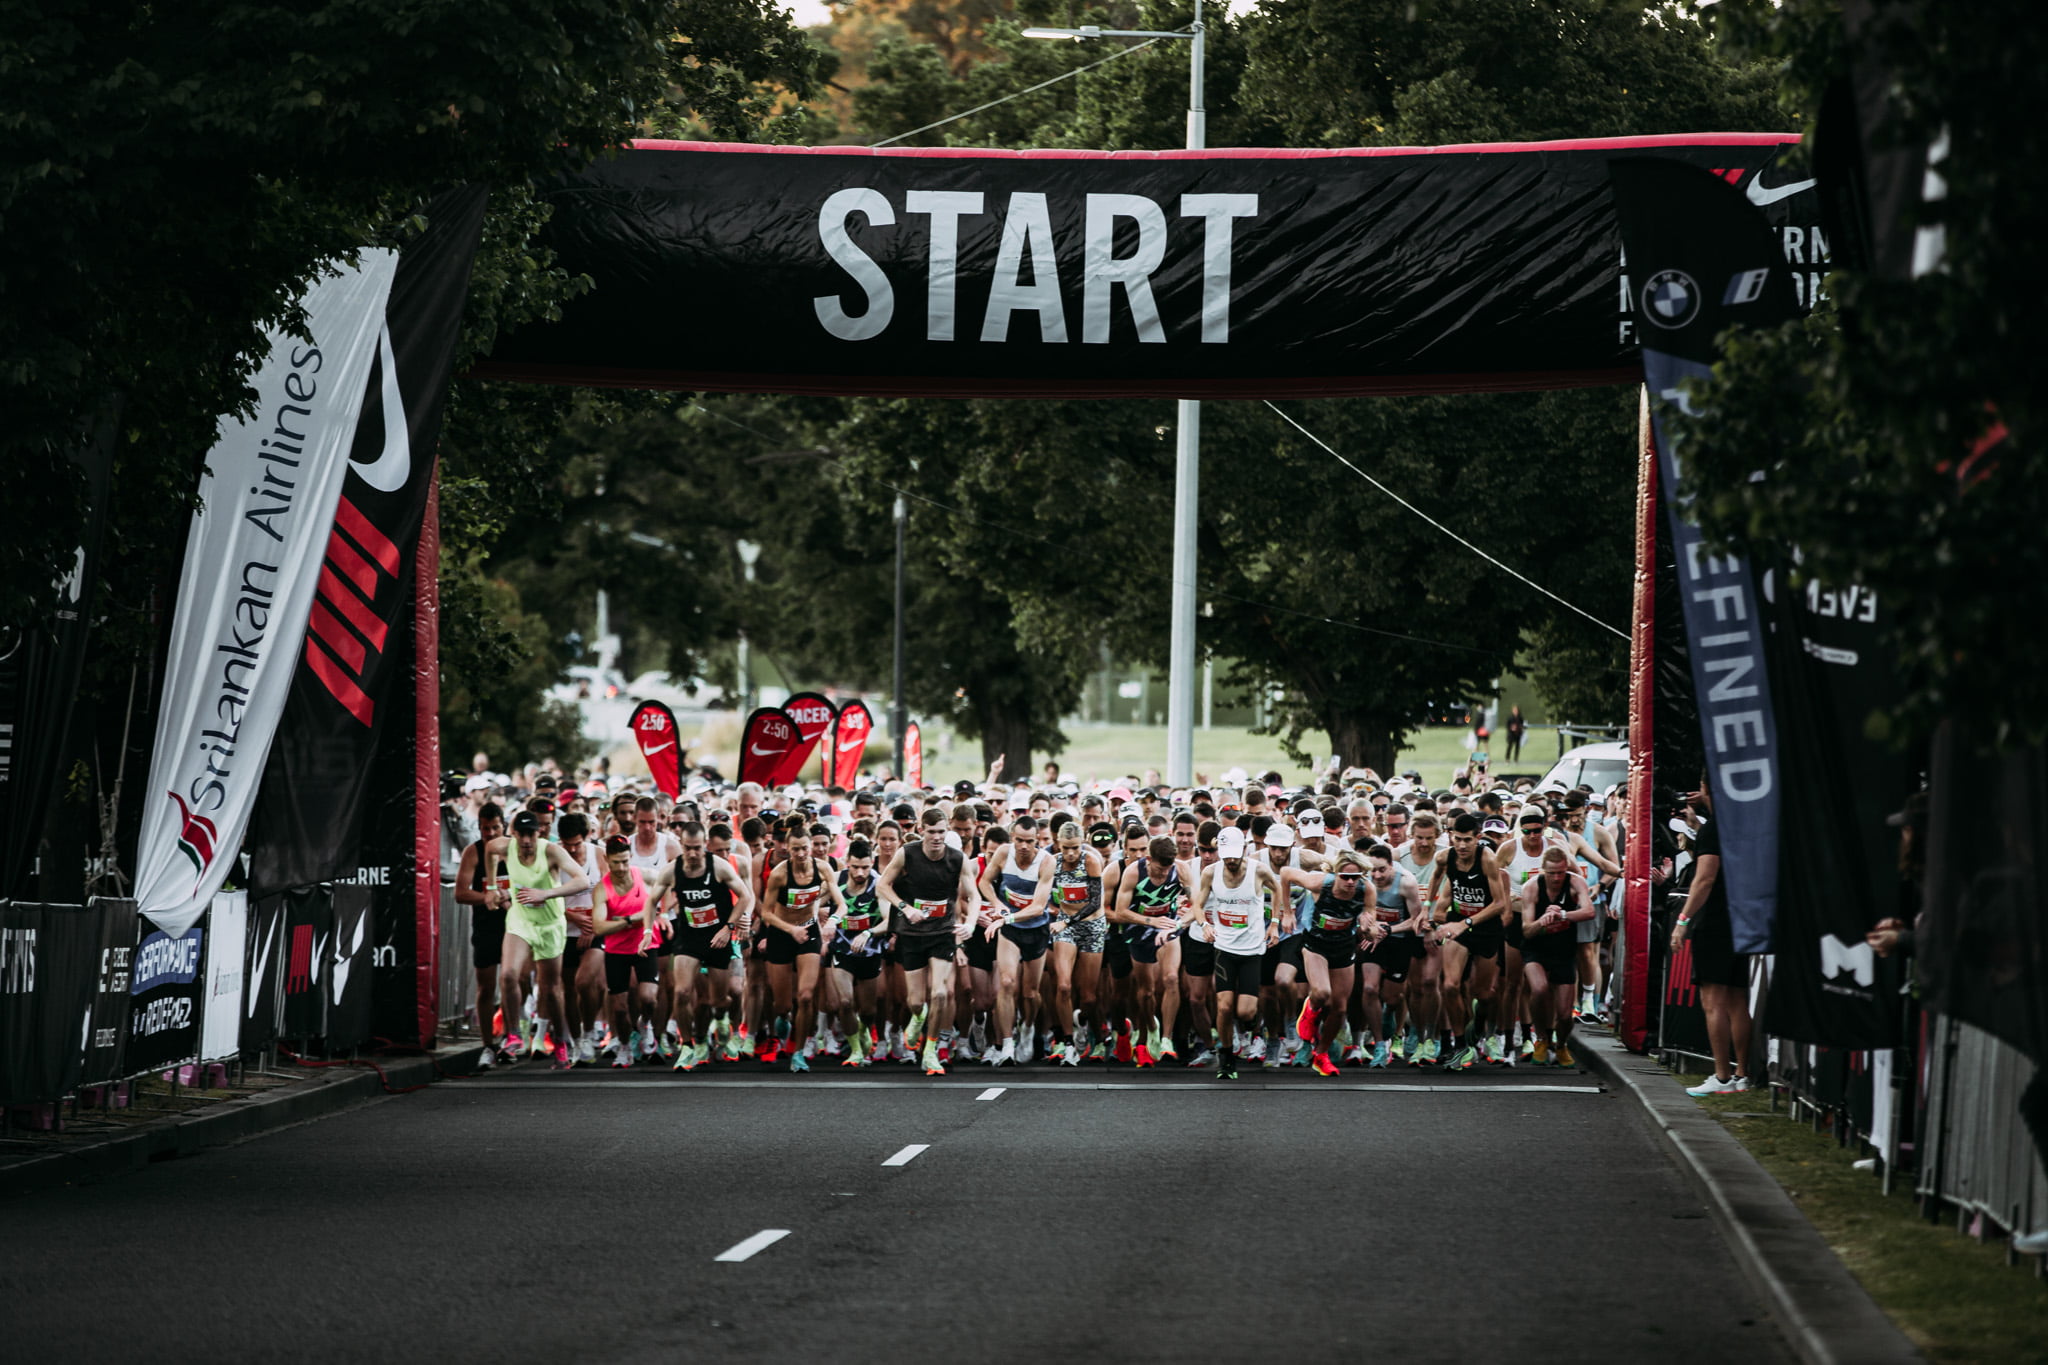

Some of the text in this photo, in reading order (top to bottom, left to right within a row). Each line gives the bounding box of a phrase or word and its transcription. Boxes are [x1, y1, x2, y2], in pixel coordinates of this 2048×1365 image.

[813, 187, 1259, 344] START
[190, 345, 324, 811] SriLankan Airlines
[785, 707, 830, 725] PACER
[762, 719, 790, 741] 2:50
[682, 889, 713, 900] TRC
